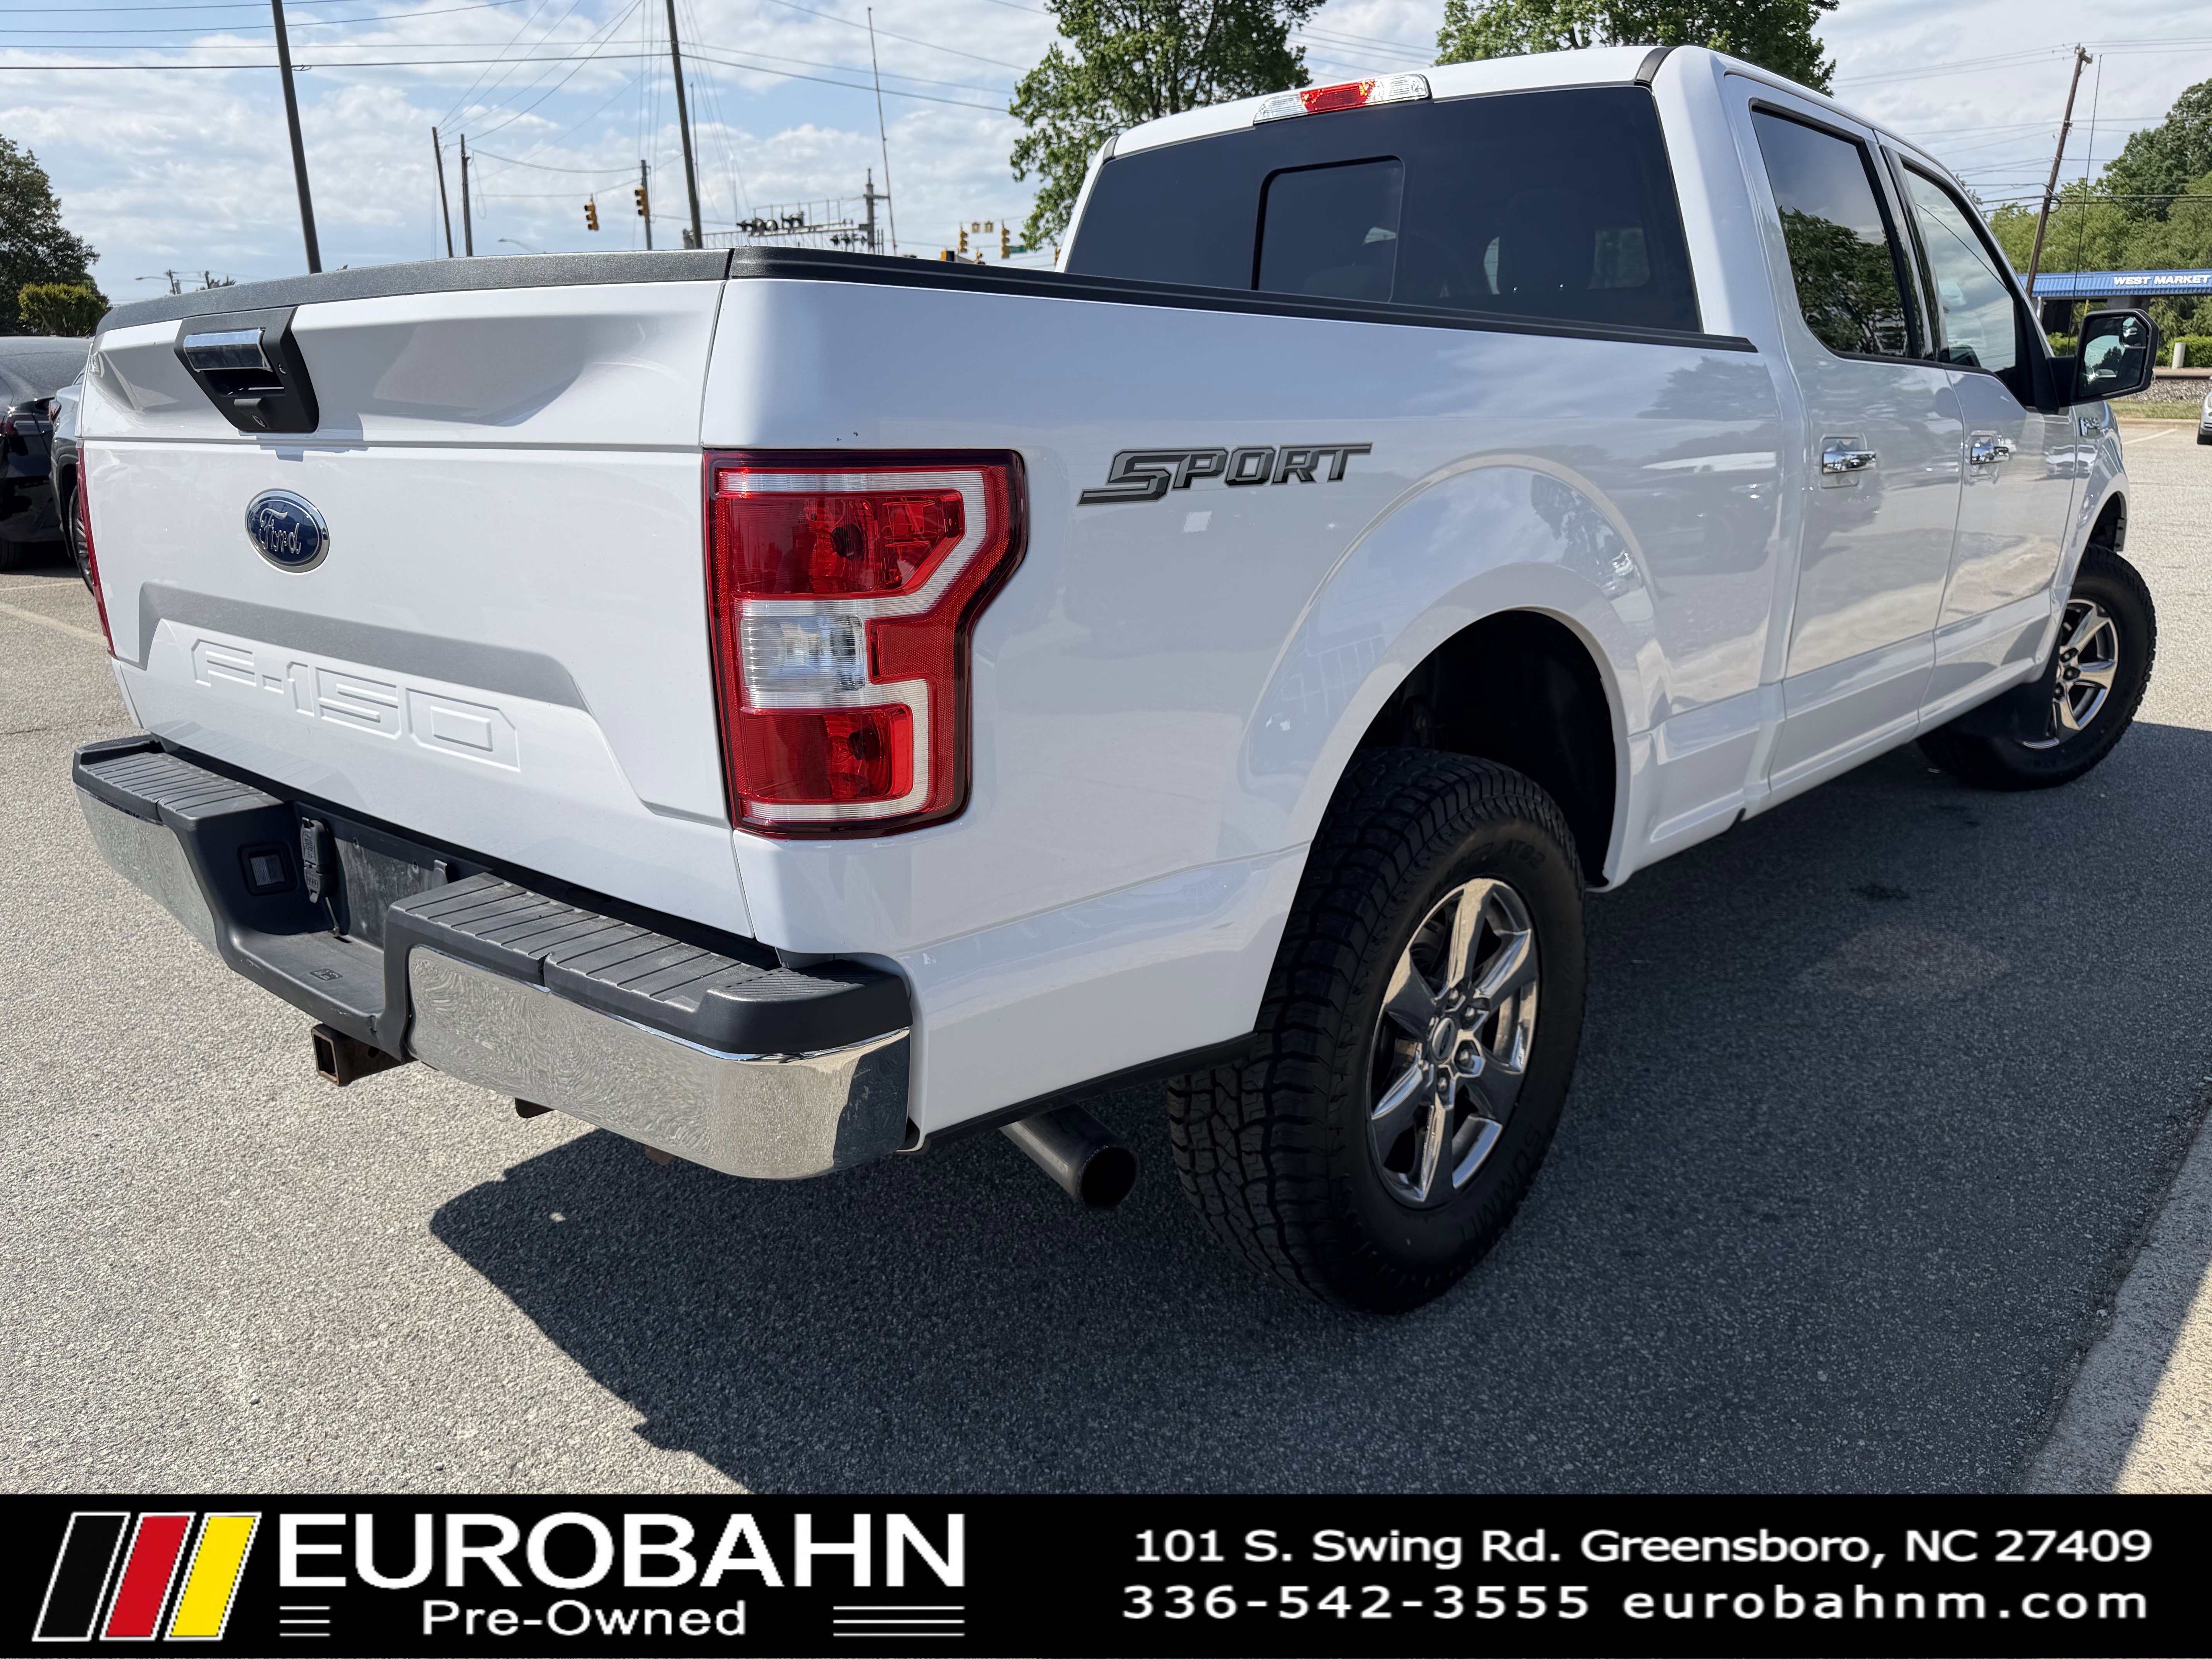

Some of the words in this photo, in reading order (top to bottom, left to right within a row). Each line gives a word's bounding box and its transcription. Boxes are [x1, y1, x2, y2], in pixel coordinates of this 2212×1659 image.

[2113, 276, 2151, 285] WEST
[2154, 275, 2211, 285] MARKET
[1077, 442, 1373, 507] SPORT
[259, 507, 302, 555] Ford
[191, 638, 521, 773] F-150
